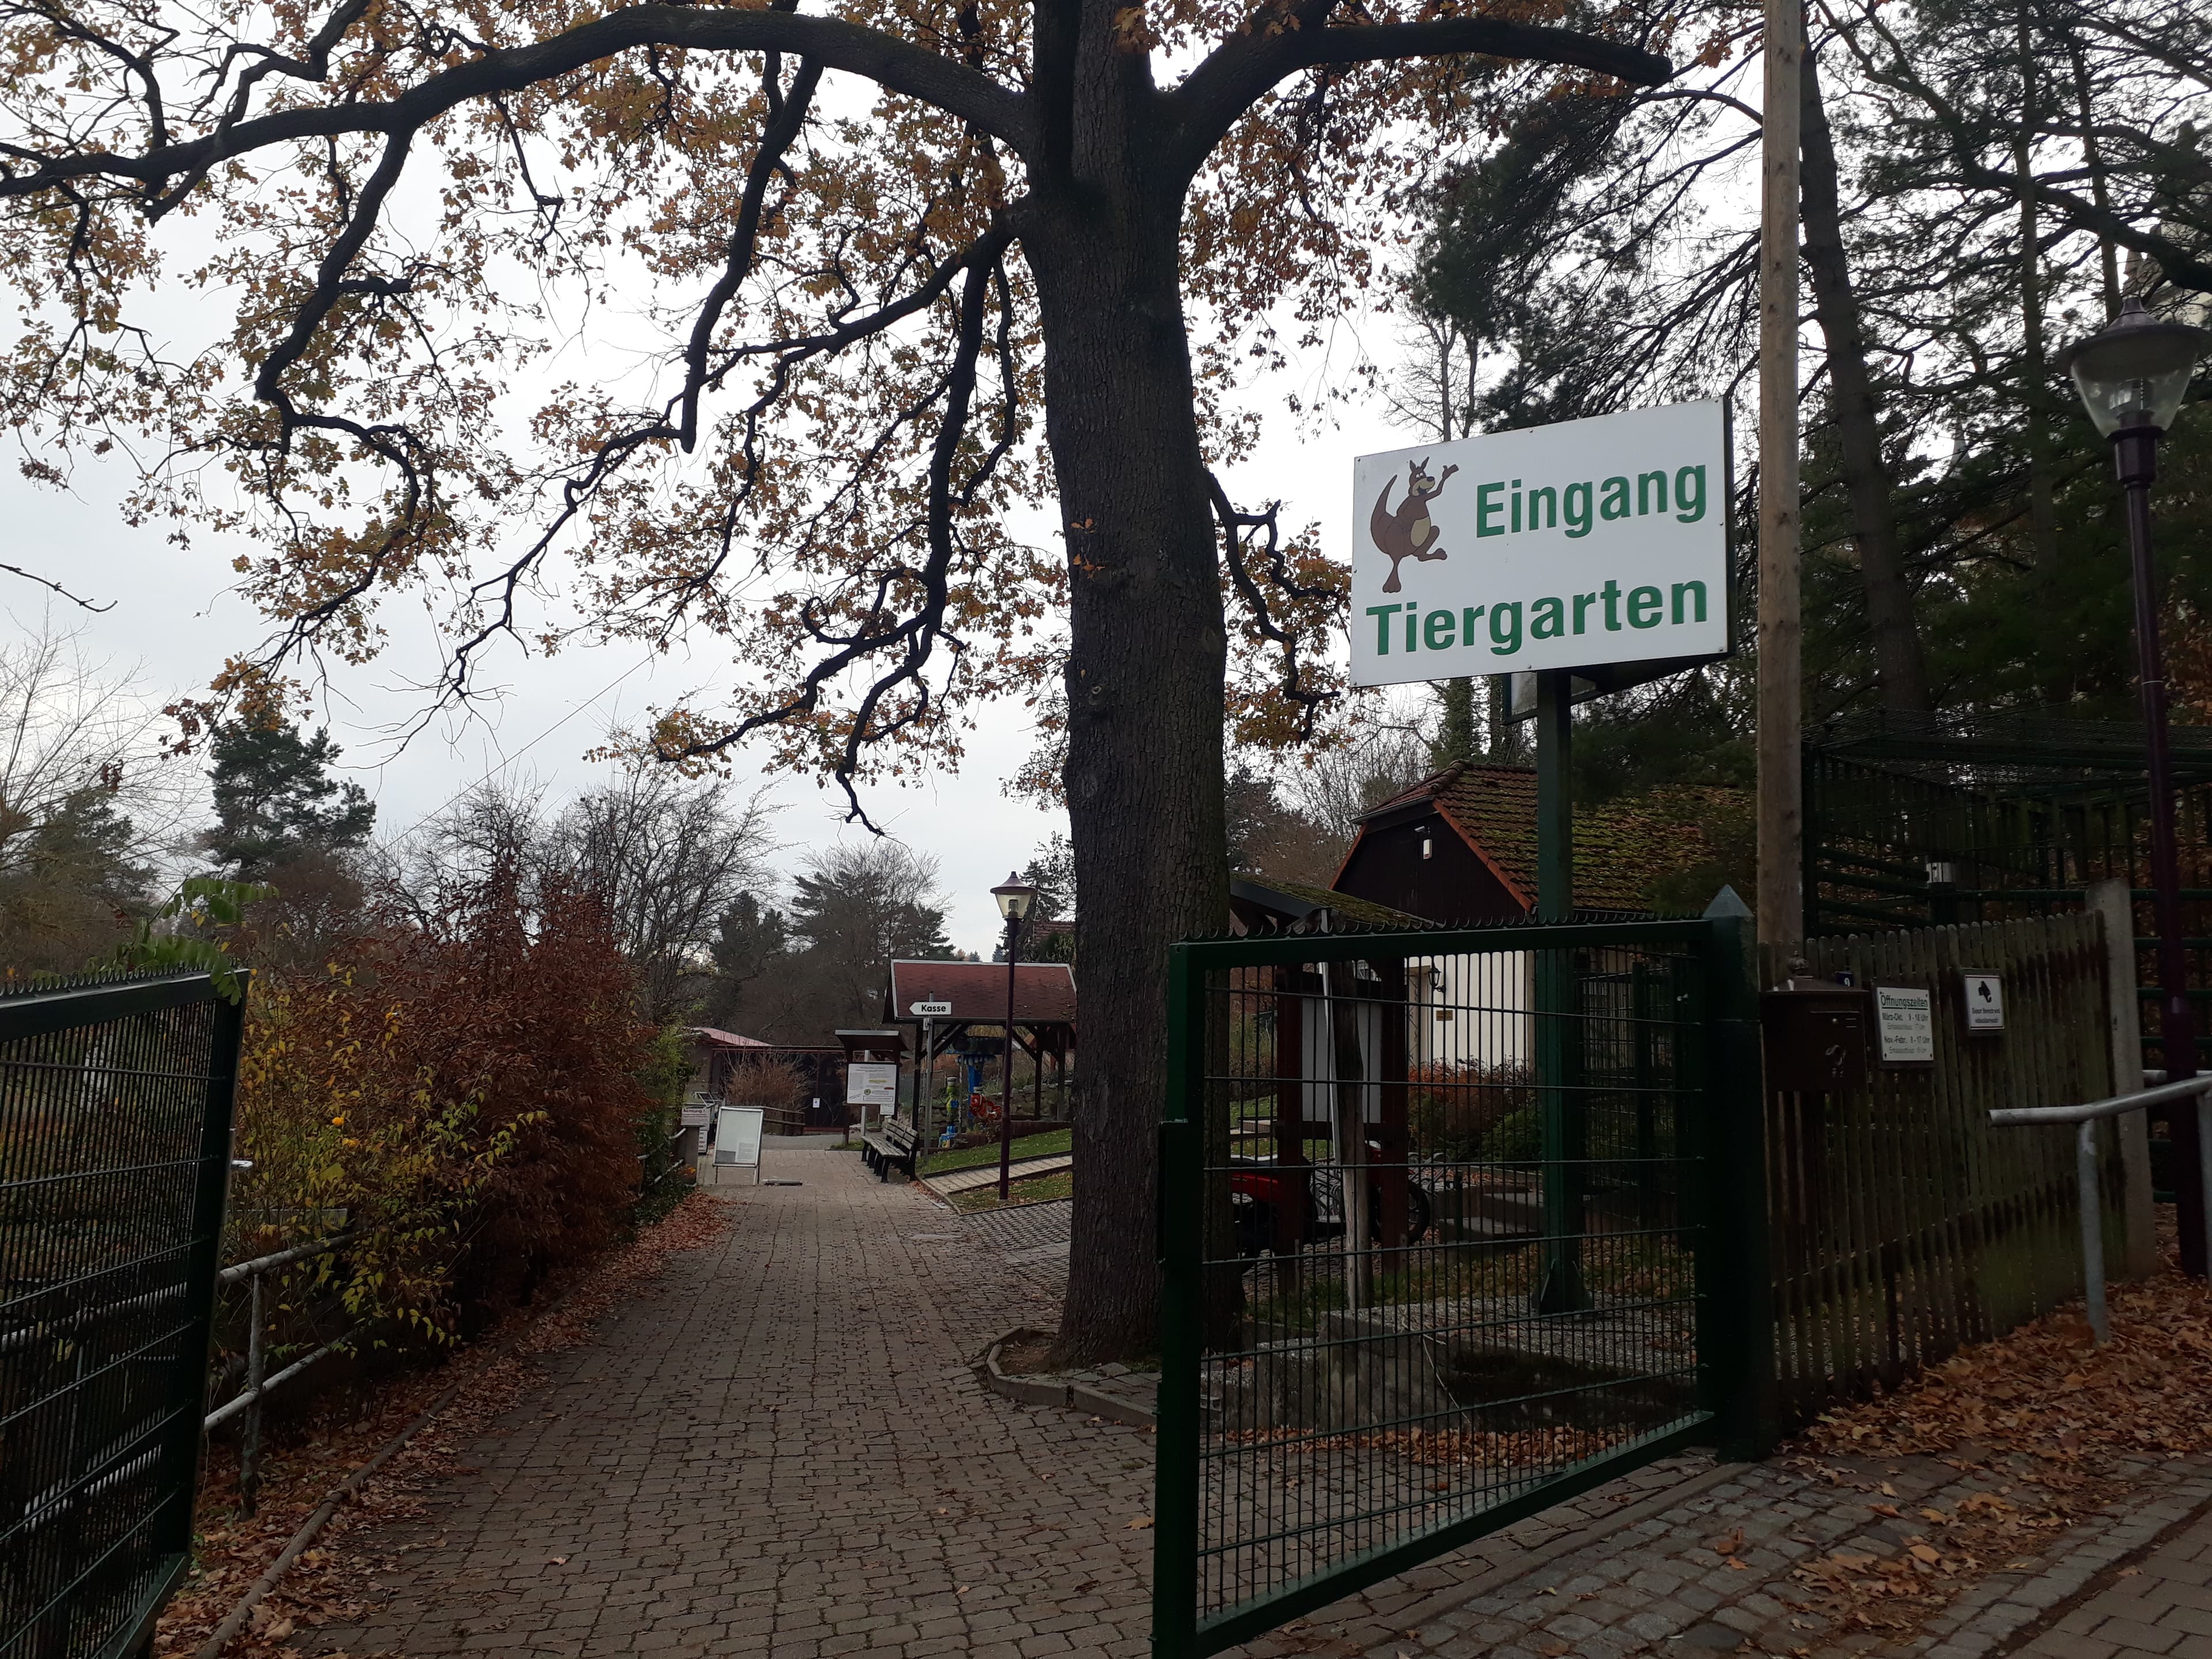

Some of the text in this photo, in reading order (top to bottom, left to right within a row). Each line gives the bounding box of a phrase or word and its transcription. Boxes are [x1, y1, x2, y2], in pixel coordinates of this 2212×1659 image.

[1476, 464, 1706, 539] Eingang
[1366, 579, 1707, 656] Tiergarten
[922, 1004, 946, 1012] Kasse
[1880, 992, 1929, 1009] Öffnungszeiten
